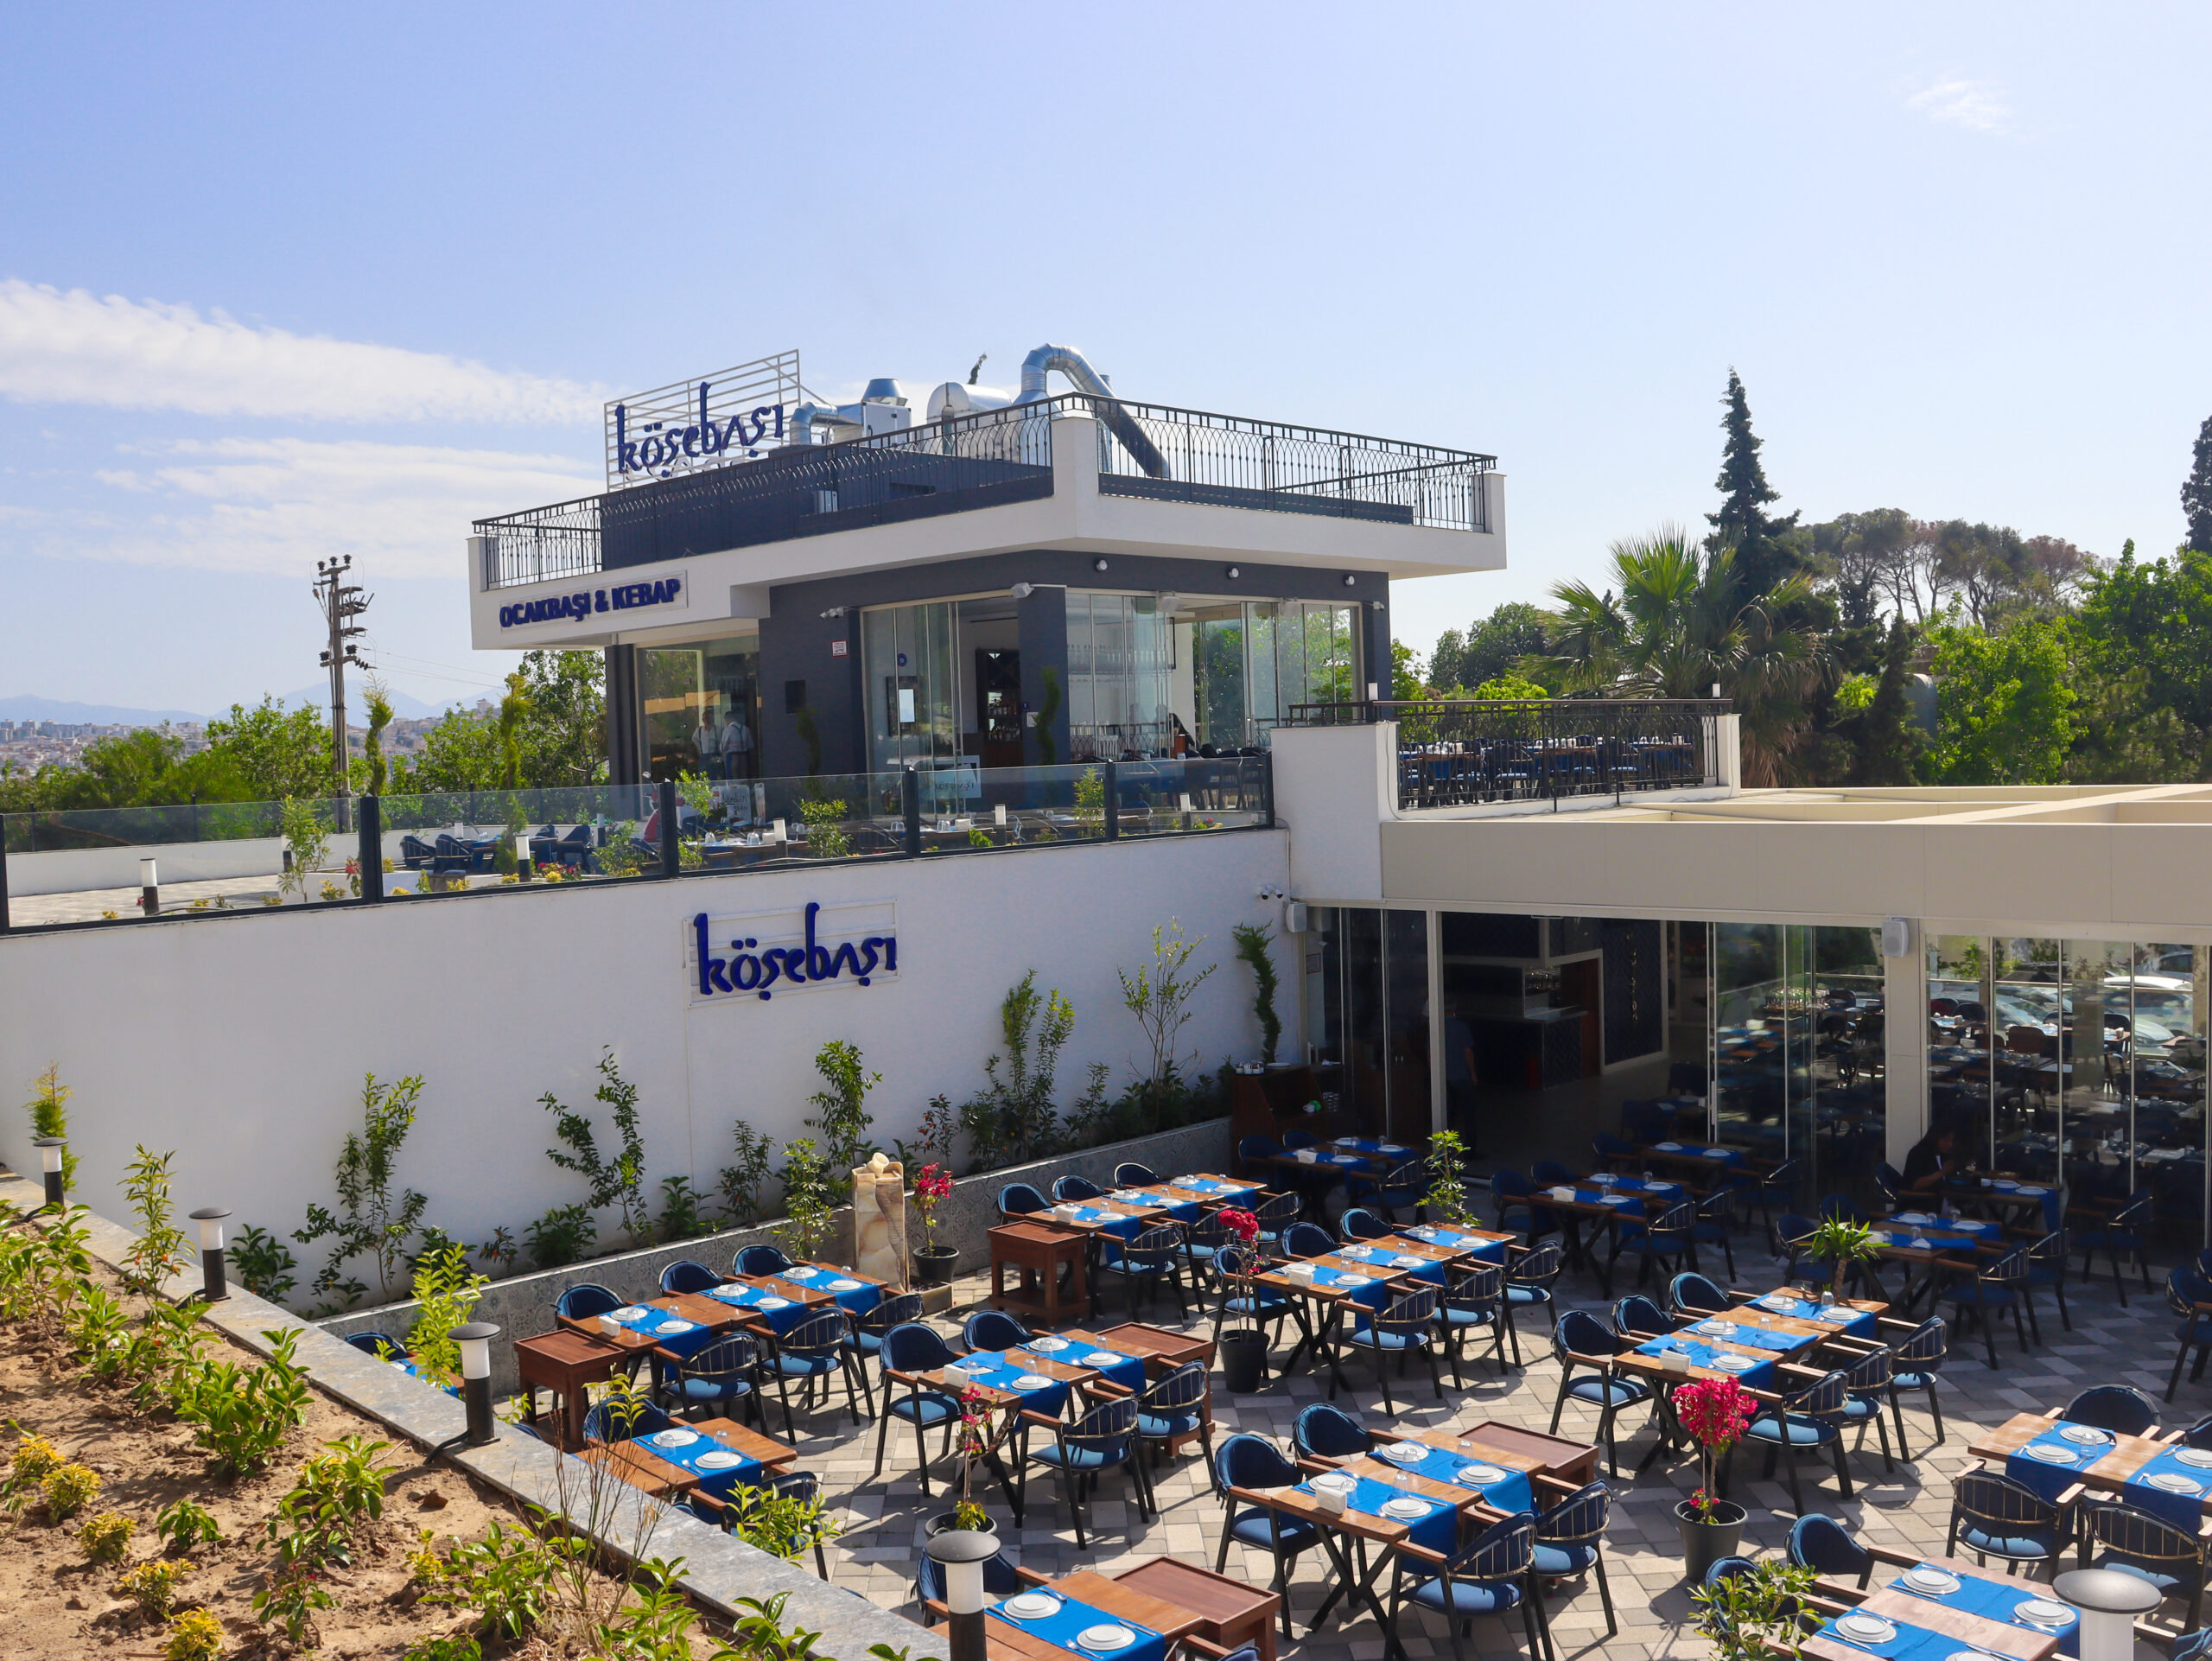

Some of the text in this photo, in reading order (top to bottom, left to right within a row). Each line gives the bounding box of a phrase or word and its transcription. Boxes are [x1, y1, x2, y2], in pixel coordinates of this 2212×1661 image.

[499, 578, 682, 628] OCAKBAŞI & KEBAP
